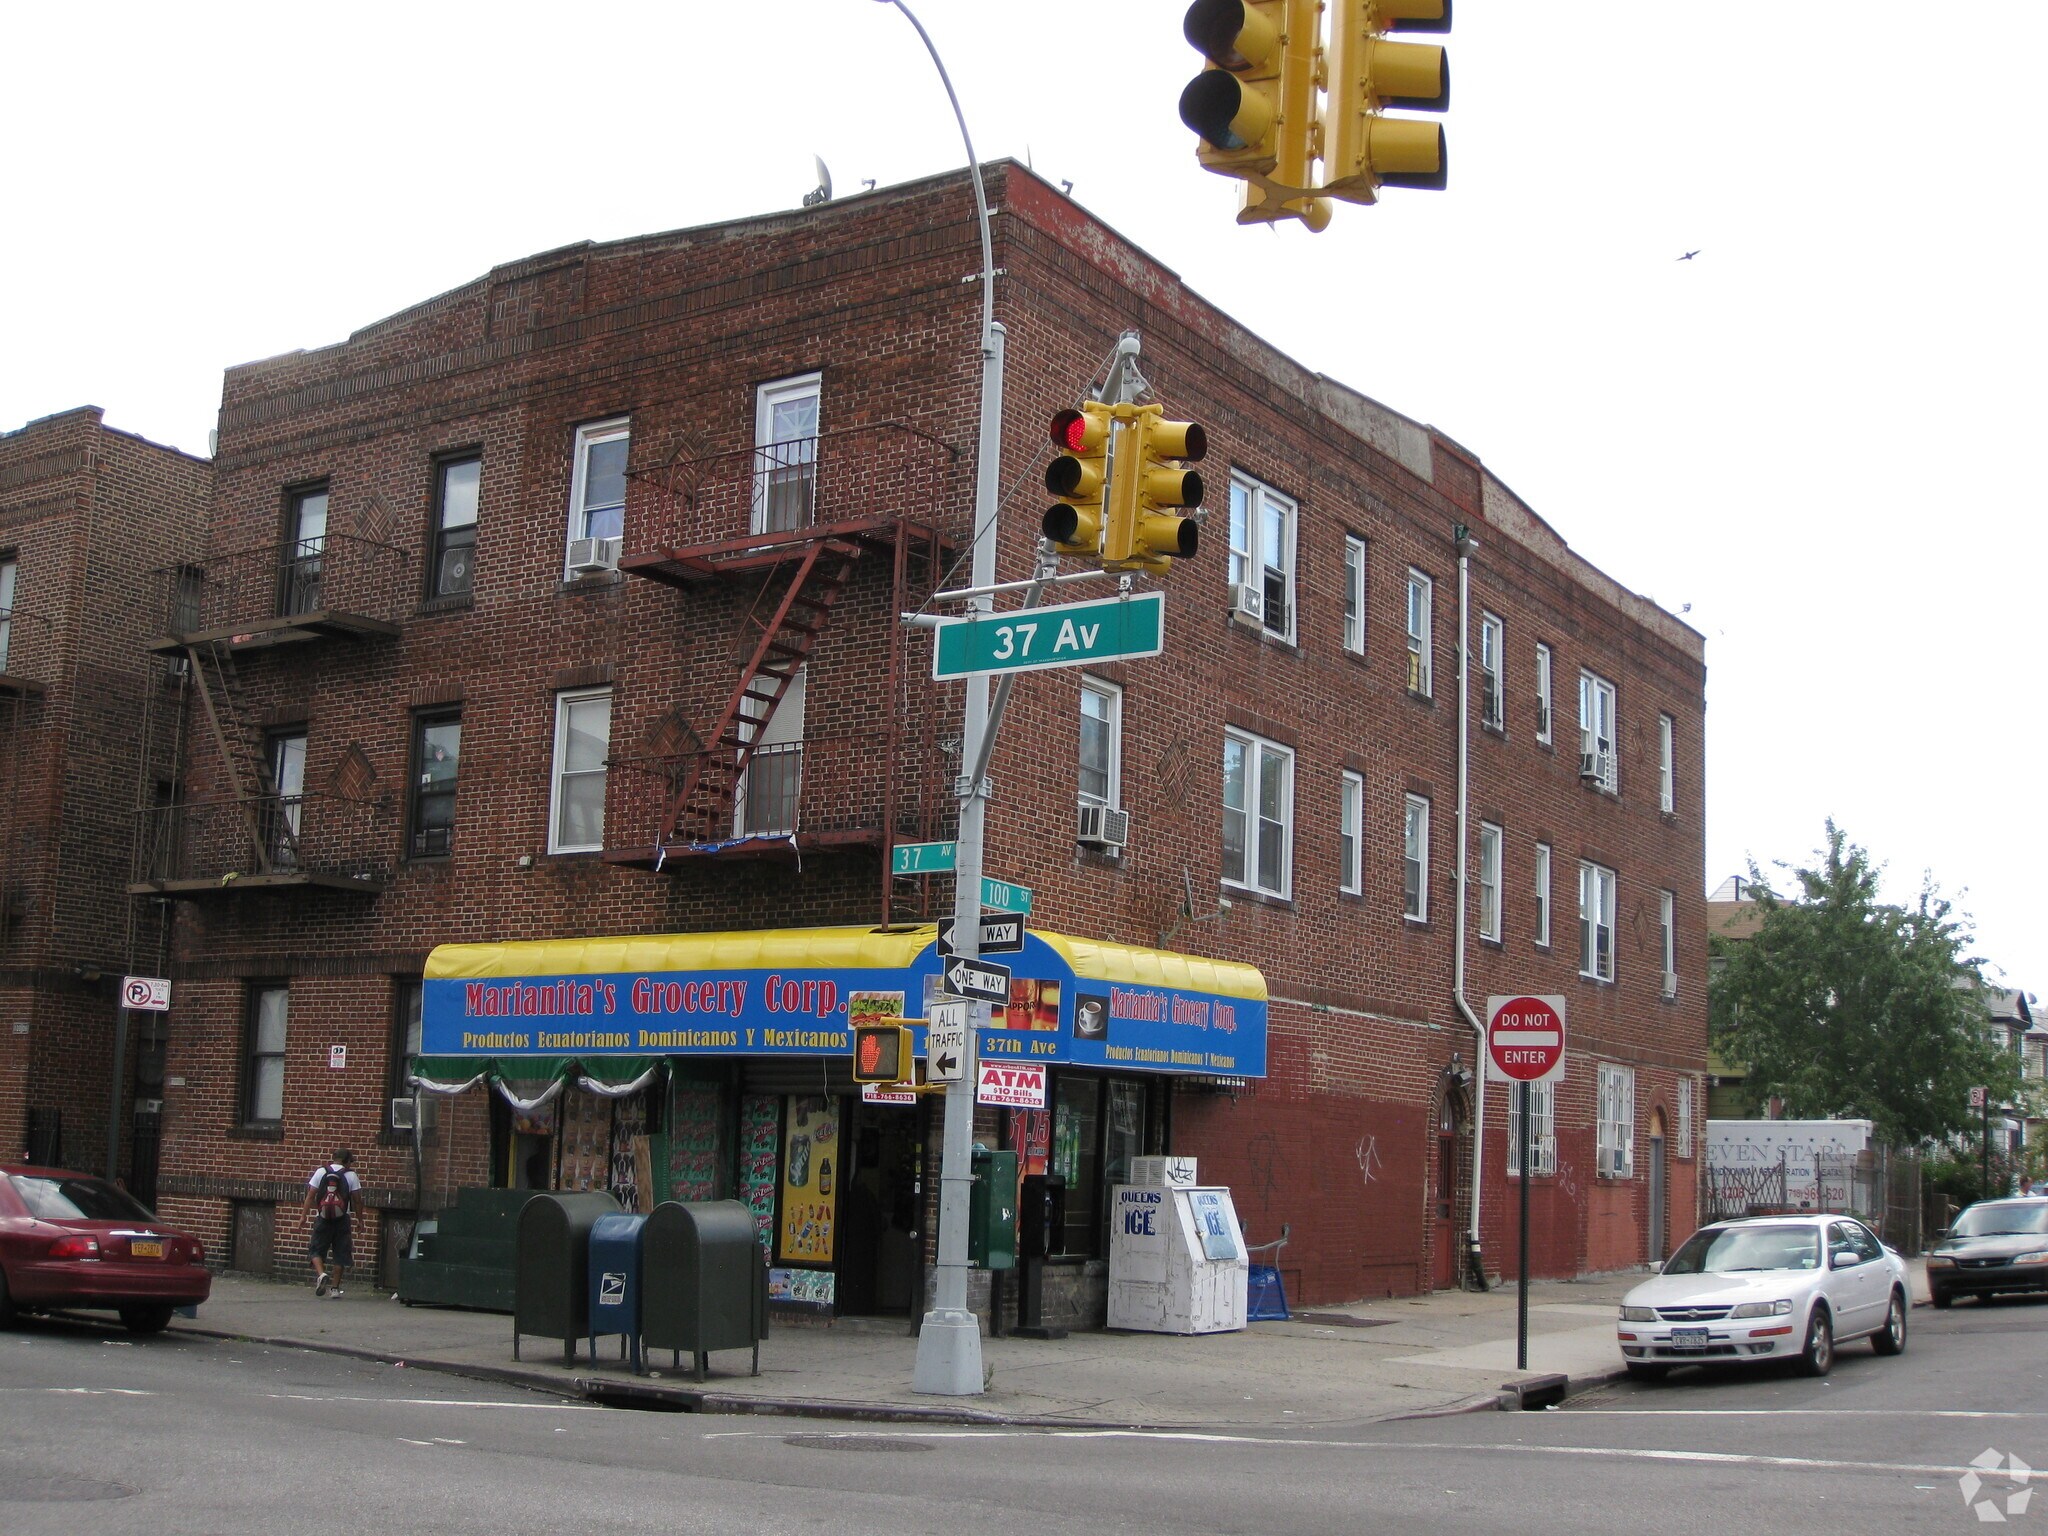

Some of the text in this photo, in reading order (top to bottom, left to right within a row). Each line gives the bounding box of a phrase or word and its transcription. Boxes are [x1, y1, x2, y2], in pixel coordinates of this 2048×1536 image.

[993, 618, 1100, 660] 37 Av
[901, 845, 951, 870] 37 AV
[989, 883, 1029, 907] 100 ST
[986, 925, 1012, 942] WAY
[954, 968, 1003, 992] ONE WAY
[465, 974, 847, 1019] Marianita's Grocery Corp.
[938, 1008, 958, 1028] ALL
[1109, 986, 1238, 1035] Marianita's Grocery Corp.
[1502, 1014, 1550, 1027] DO NOT
[463, 1028, 848, 1048] Productos Ecuatorianos Dominicanos Y Mexicanos
[931, 1031, 963, 1049] TRAFFIC
[987, 1038, 1057, 1055] 37th Ave
[1105, 1044, 1133, 1061] Productos
[1135, 1046, 1169, 1063] Ecuatorianos
[1171, 1049, 1203, 1066] Dominicanos
[1210, 1052, 1235, 1068] Mexicanos
[1504, 1051, 1546, 1064] ENTER
[982, 1069, 1042, 1089] ATM
[983, 1094, 1040, 1105] 718-766-8636
[993, 1087, 1032, 1097] $10 Bills
[1706, 1143, 1847, 1163] EVEN STARS
[1121, 1191, 1162, 1204] QUEENS
[1197, 1195, 1218, 1205] QUEENS
[756, 1216, 773, 1228] iZona
[1125, 1206, 1156, 1236] ICE
[1204, 1210, 1225, 1236] ICE
